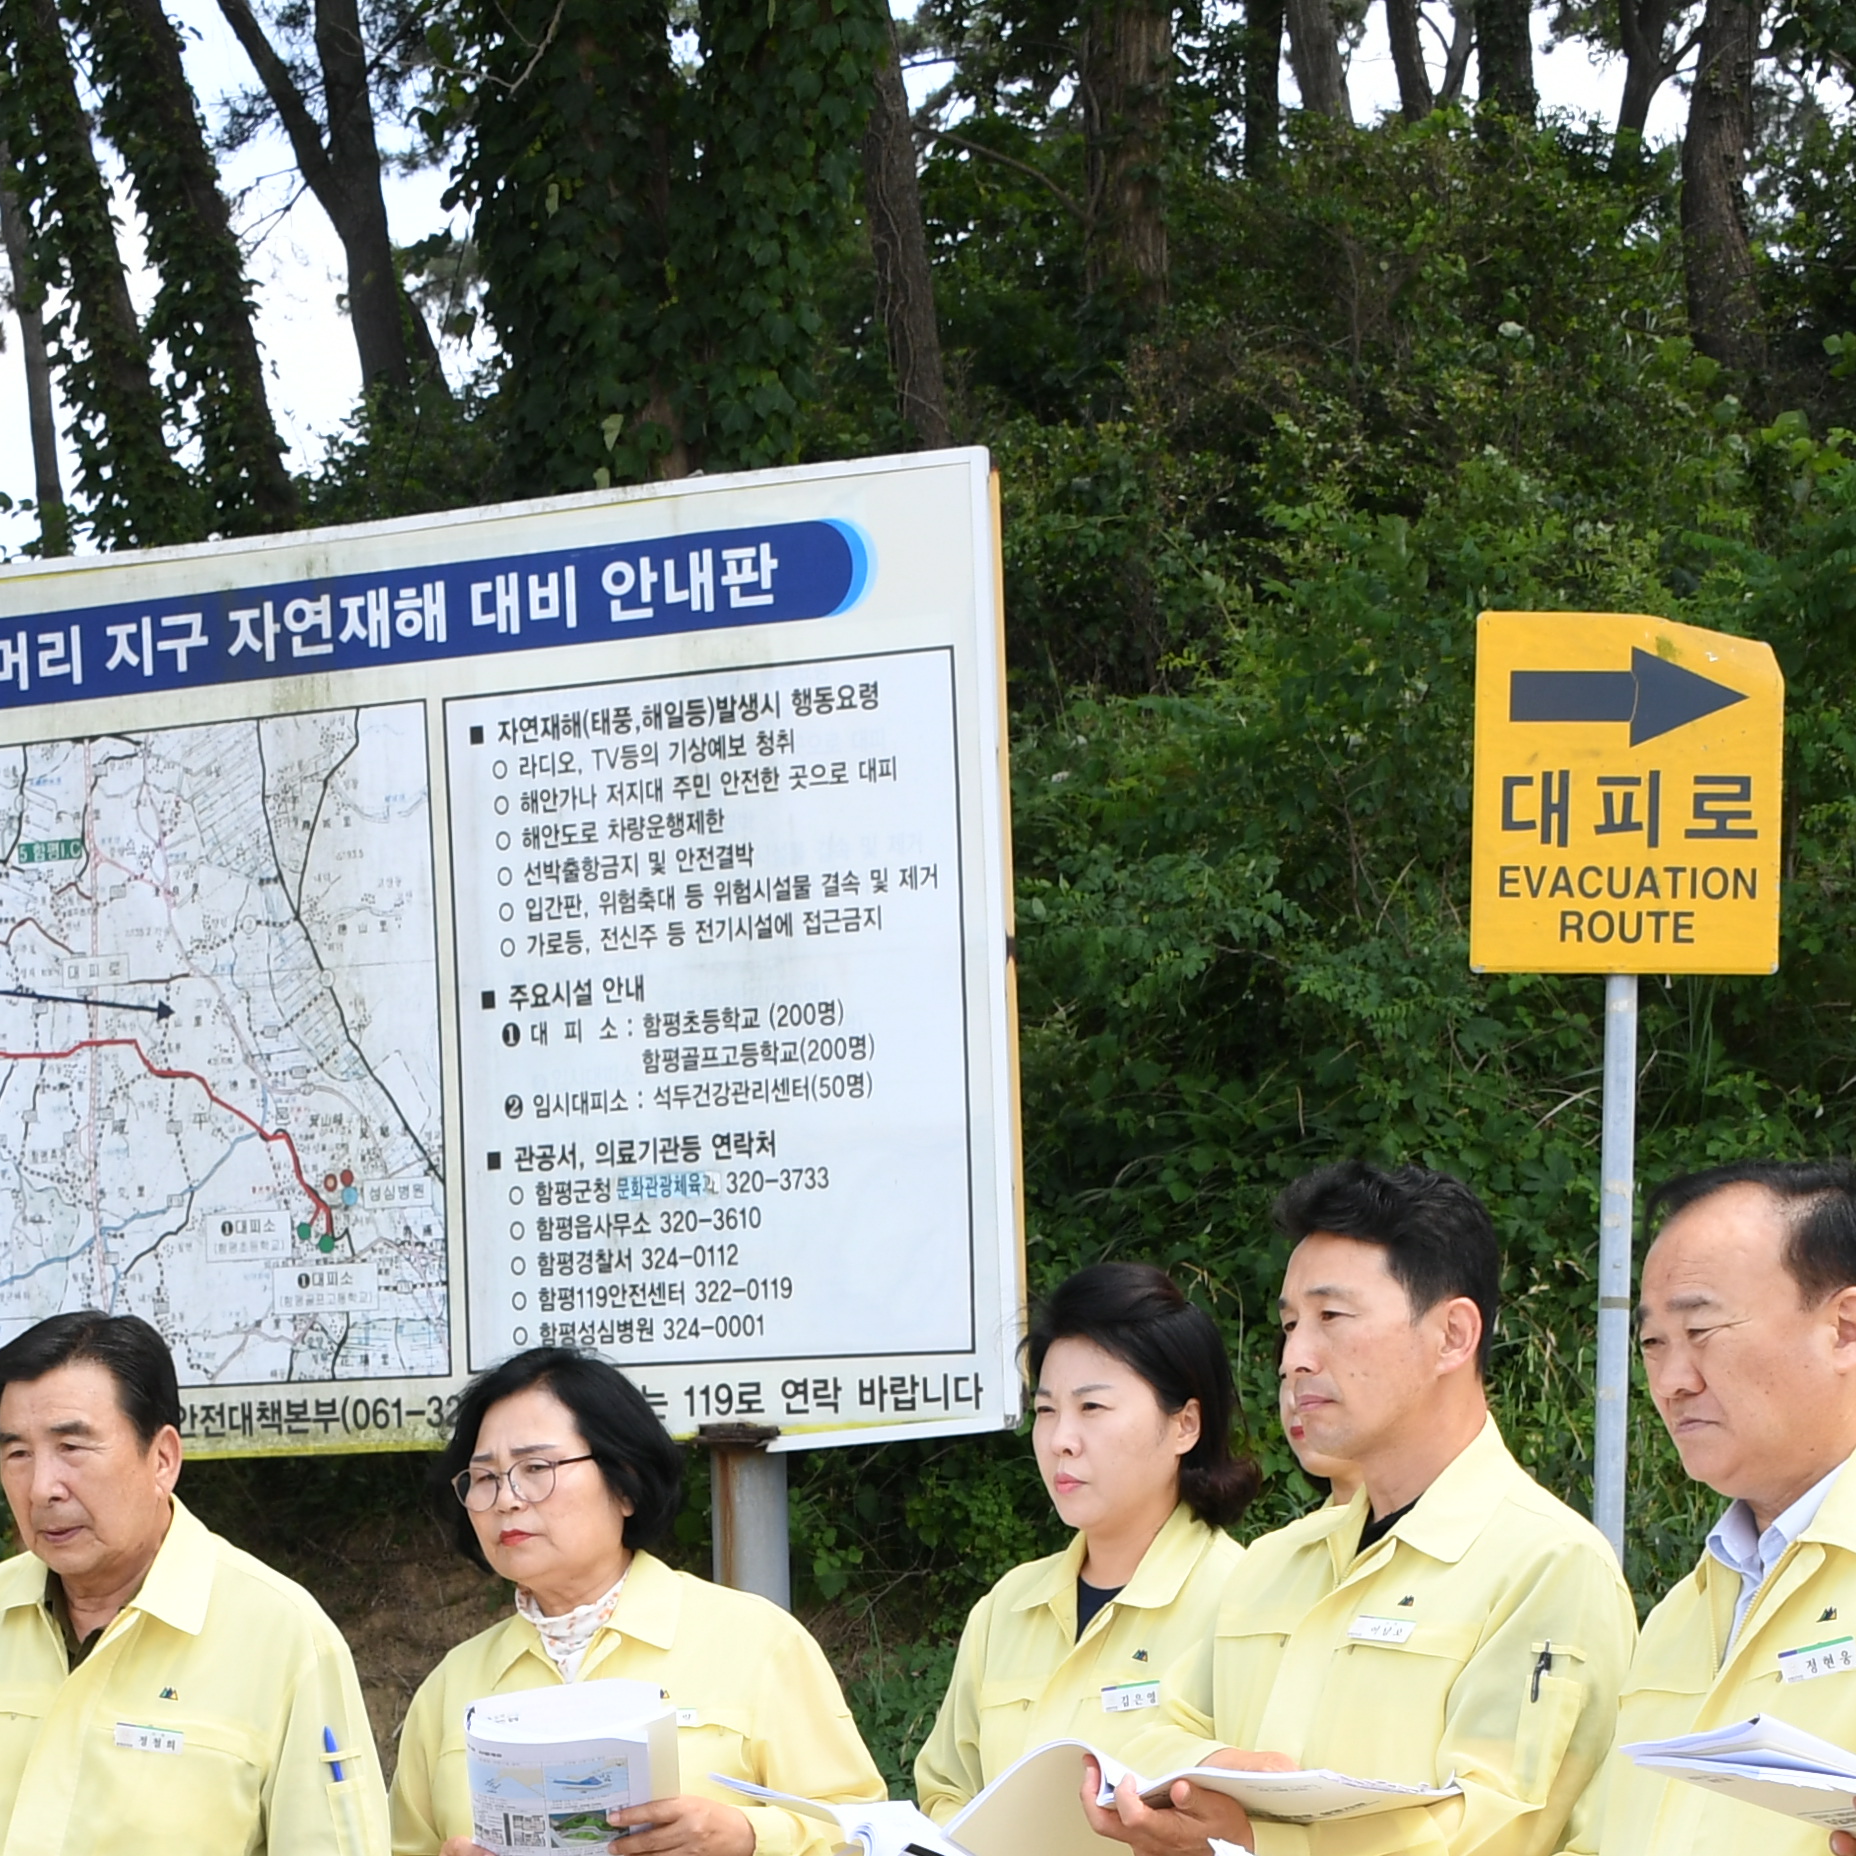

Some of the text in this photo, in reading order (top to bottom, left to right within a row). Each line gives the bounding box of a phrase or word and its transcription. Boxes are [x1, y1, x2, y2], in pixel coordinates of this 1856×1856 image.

[106, 611, 211, 679] 지구
[228, 580, 448, 664] 자연재해
[470, 564, 579, 636] 대비
[601, 542, 780, 622] 안내판
[497, 680, 881, 746] 자연재해(태풍,해일등)발생시 행동요령
[518, 728, 796, 779] 라디오, TV등의 기상예보 청취
[520, 755, 898, 817] 해안가나 저지대 주민 안전한 곳으로 대피
[521, 807, 725, 852] 해안도로 차량운행제한
[1501, 768, 1759, 849] 대피로
[523, 841, 755, 888] 선박출항금지 및 안전결박
[1498, 865, 1758, 900] EVACUATION
[525, 863, 940, 925] 입간판, 위험축대 등 위험시설물 결속 및 제거
[526, 904, 884, 959] 가로등, 전신주 등 전기시설에 접근금지
[1559, 909, 1696, 944] ROUTE
[508, 974, 646, 1012] 주요시설 안내
[642, 1007, 761, 1040] 함평초등학교
[768, 998, 846, 1030] (200명)
[641, 1033, 877, 1075] 함평골프고등학교(200명)
[531, 1091, 630, 1120] 임시대피소
[652, 1072, 874, 1111] 석두건강관리센터(50명)
[513, 1129, 778, 1172] 관공서, 의료기관등 연락처
[535, 1177, 612, 1206] 함평군청
[726, 1166, 830, 1194] 320-3733
[535, 1206, 762, 1243] 함평읍사무소 320-3610
[537, 1243, 740, 1279] 함평경찰서 324-0112
[538, 1274, 794, 1312] 함평119안전센터 322-0119
[539, 1314, 766, 1351] 함평성심병원 324-0001
[683, 1382, 766, 1418] 119로
[780, 1376, 843, 1414] 연락
[857, 1371, 984, 1412] 바랍니다
